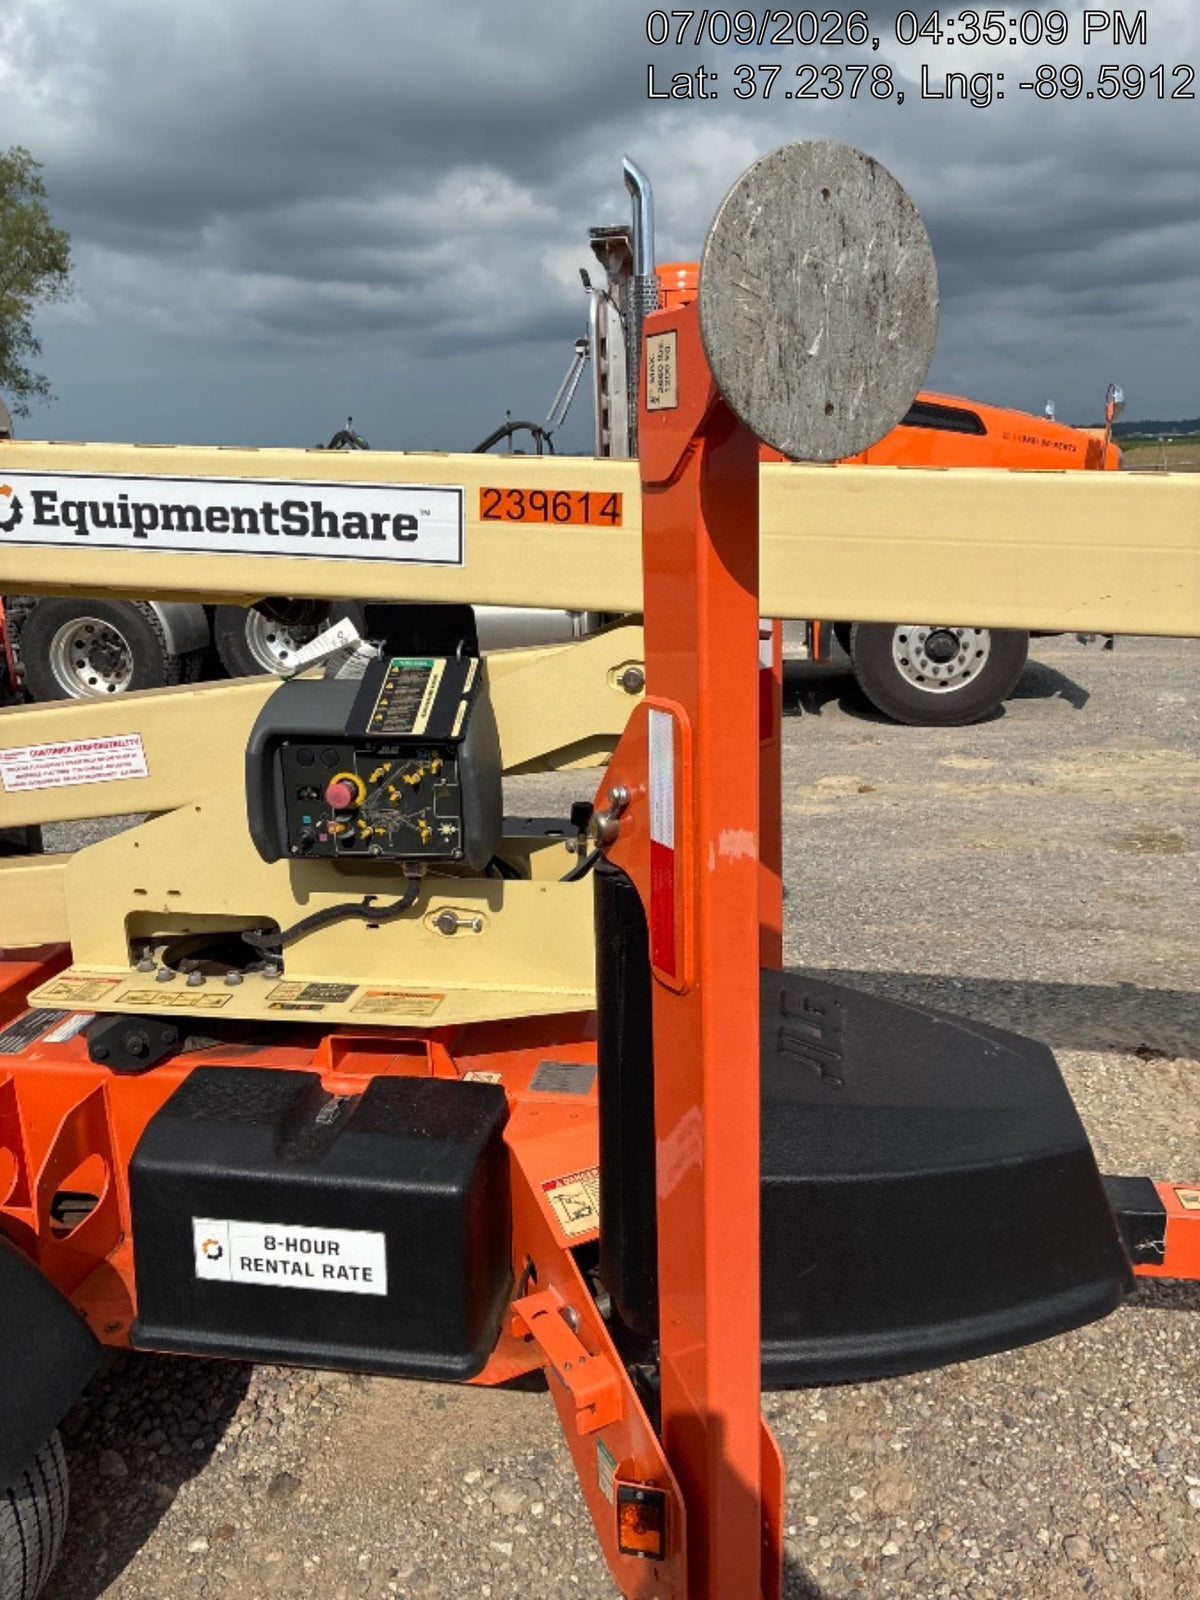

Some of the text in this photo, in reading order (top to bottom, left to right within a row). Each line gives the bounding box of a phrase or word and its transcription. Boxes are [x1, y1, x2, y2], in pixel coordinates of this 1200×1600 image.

[30, 489, 419, 543] EquipmentShare
[483, 488, 620, 524] 239614
[263, 1235, 341, 1256] 8-HOUR
[240, 1256, 373, 1283] RENTAL RATE
